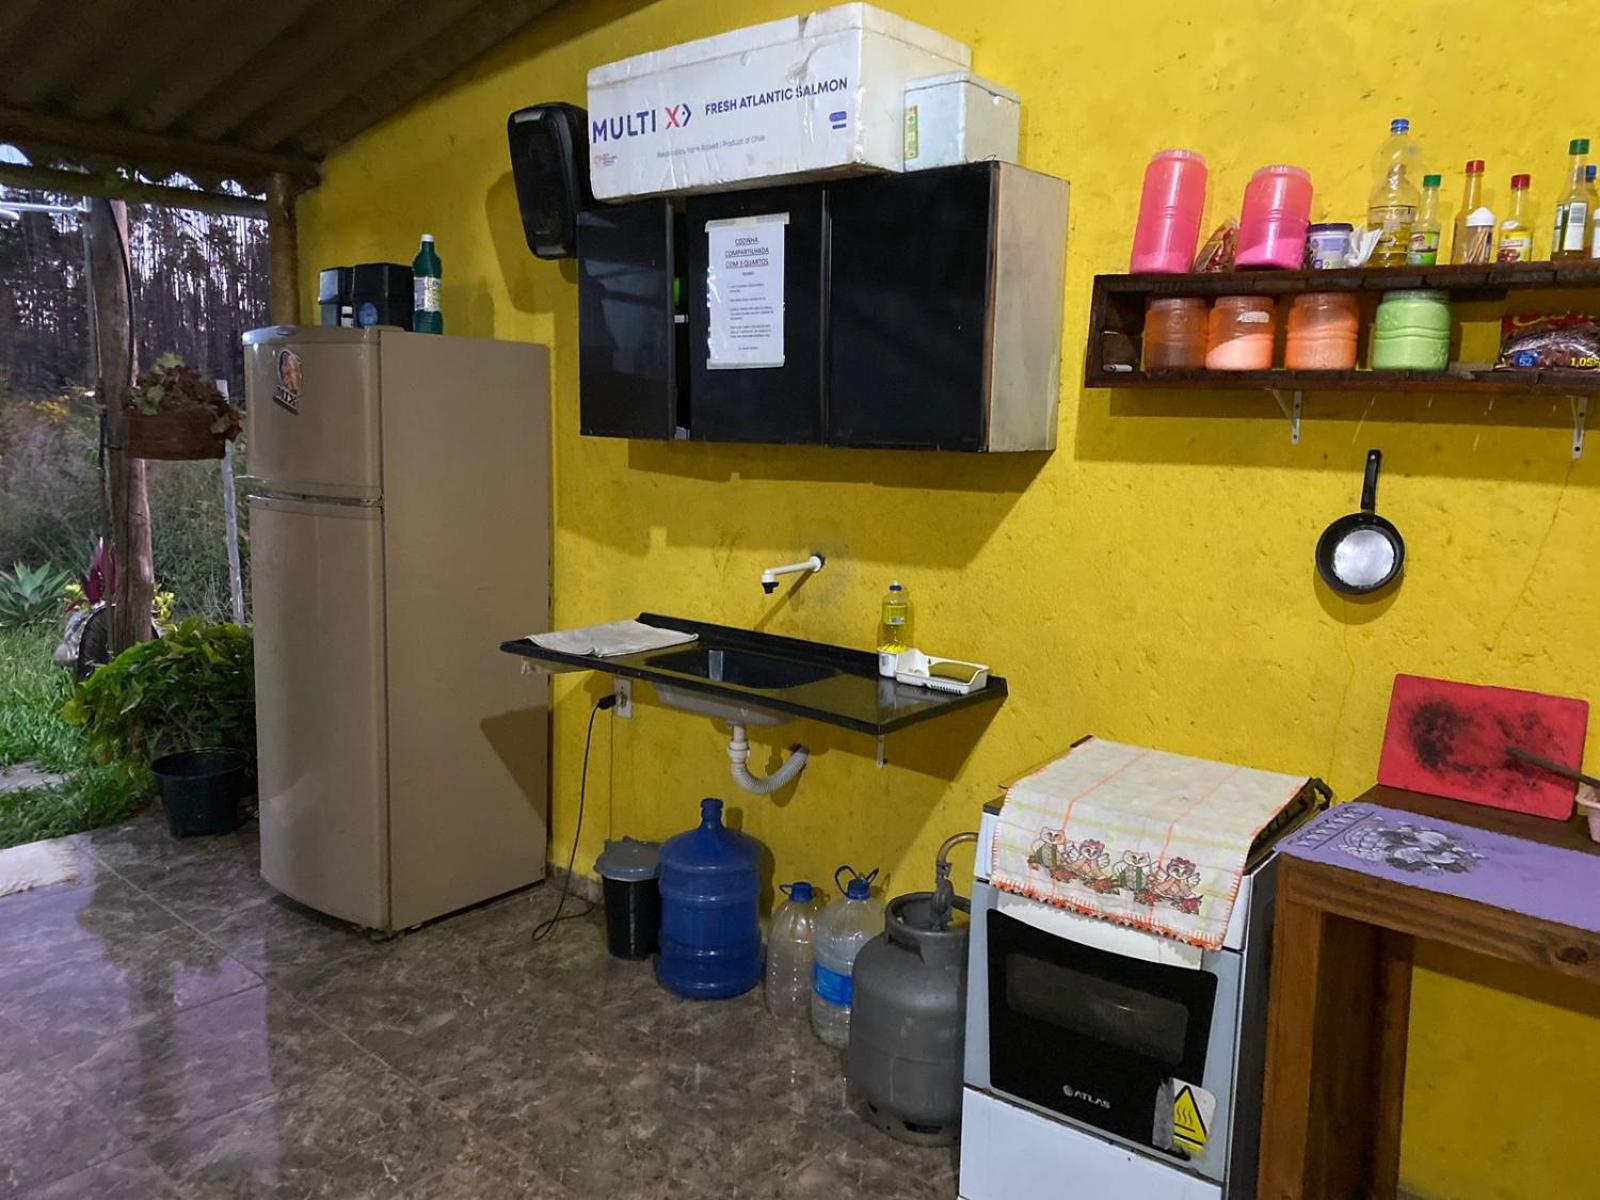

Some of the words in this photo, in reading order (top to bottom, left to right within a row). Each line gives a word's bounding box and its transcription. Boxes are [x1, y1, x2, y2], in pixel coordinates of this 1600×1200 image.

[592, 109, 656, 144] MULTI
[705, 98, 737, 116] FRESH
[739, 88, 794, 109] ATLANTIC
[795, 77, 848, 98] SALMON
[1074, 1090, 1110, 1109] ATLAS
